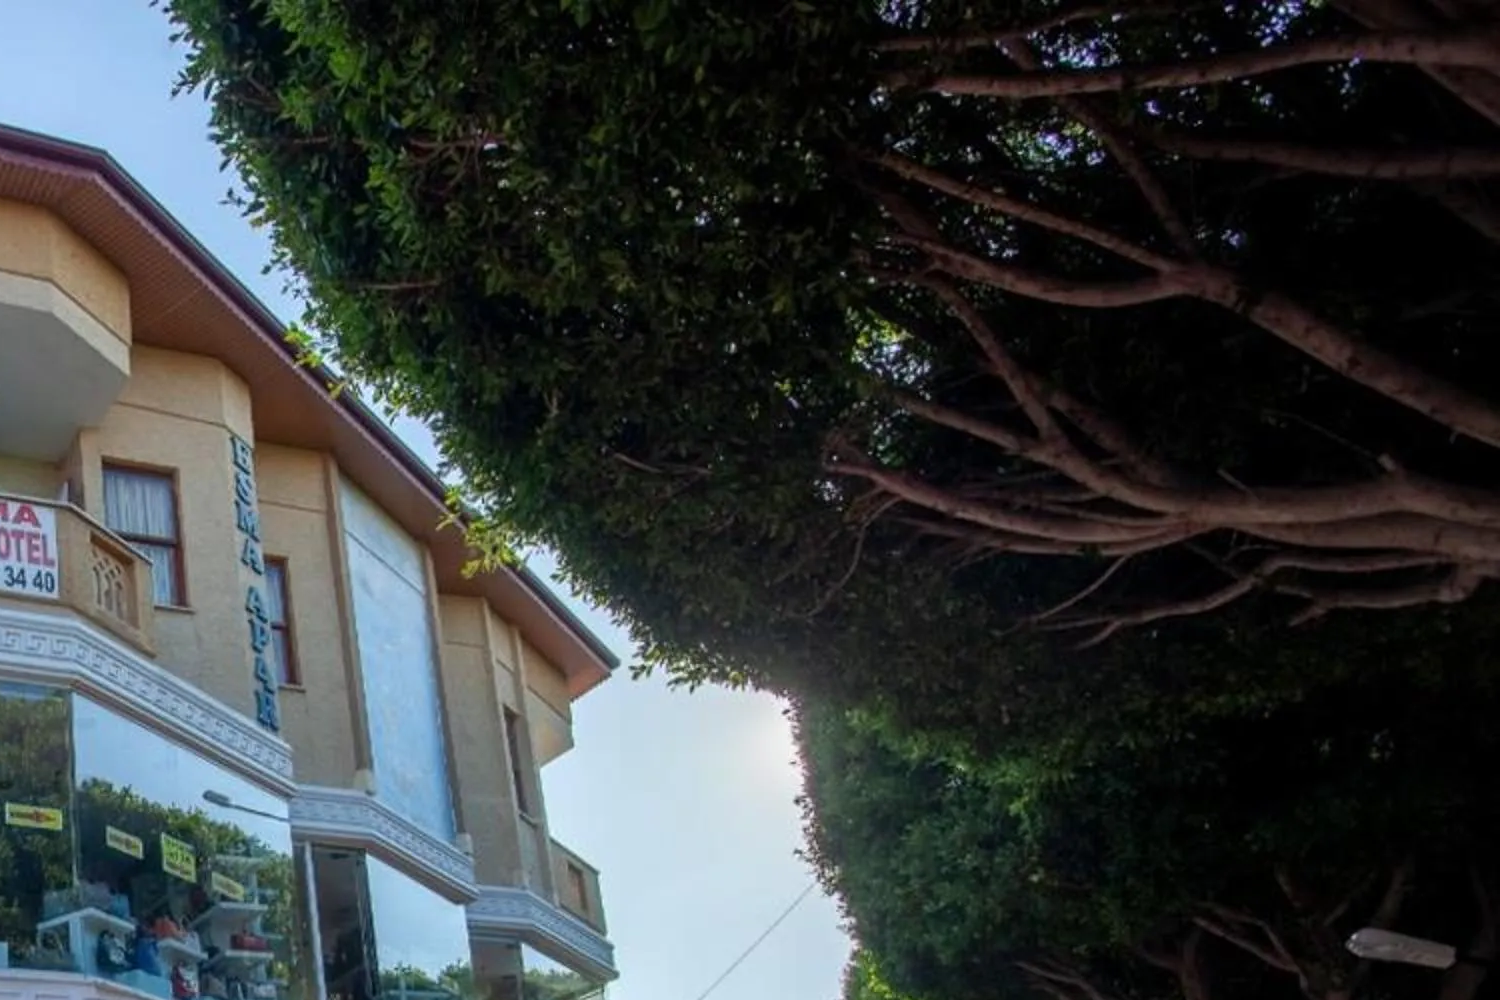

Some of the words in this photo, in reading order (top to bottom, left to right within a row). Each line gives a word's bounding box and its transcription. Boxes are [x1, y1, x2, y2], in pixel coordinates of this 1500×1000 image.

[231, 435, 262, 576] ESMA
[4, 565, 27, 589] 34
[32, 569, 56, 594] 40
